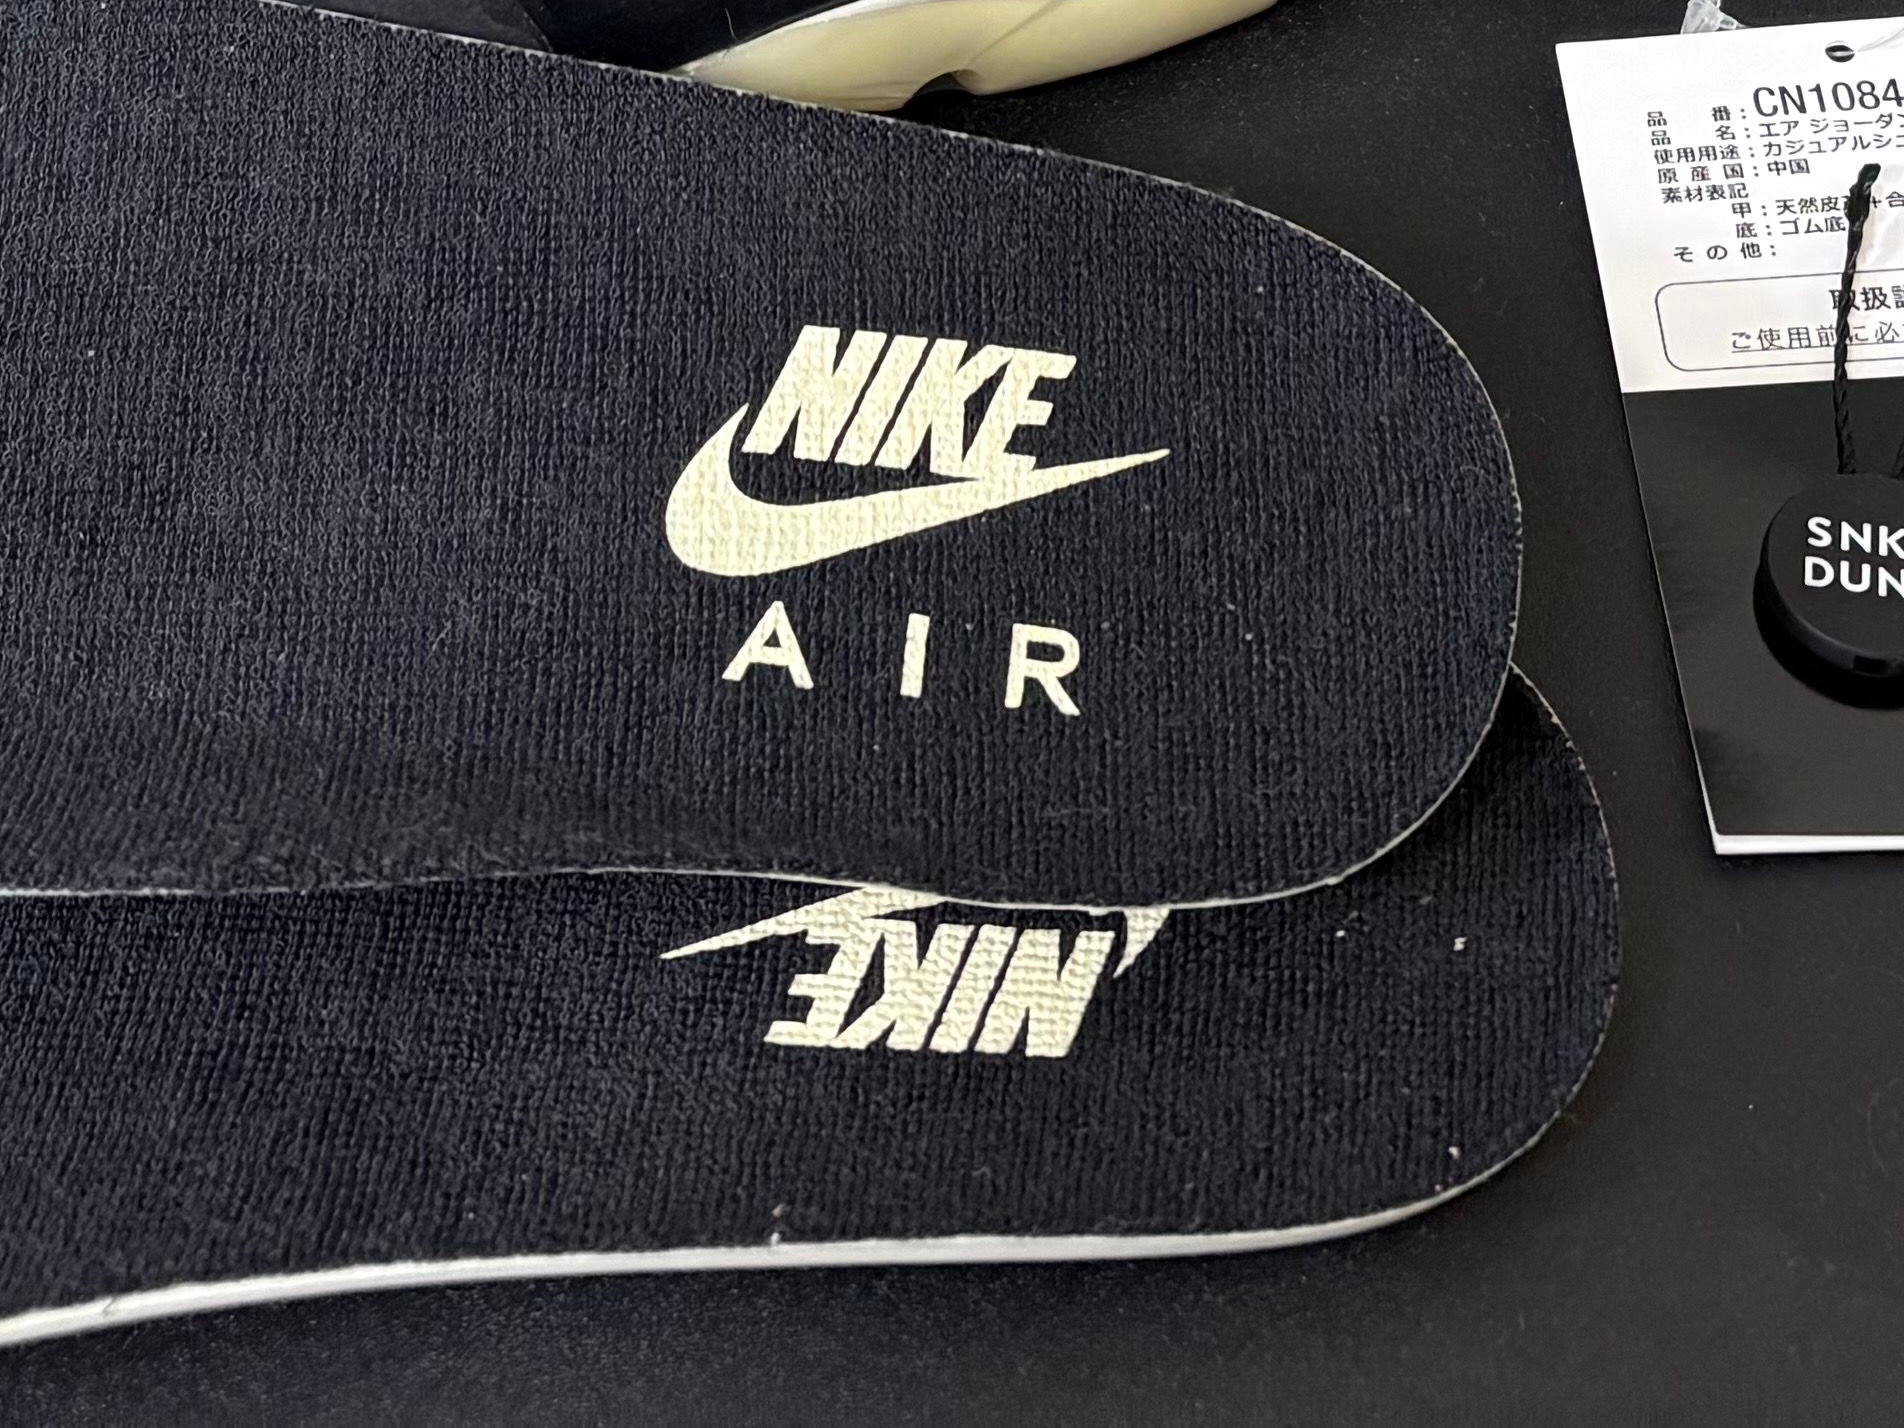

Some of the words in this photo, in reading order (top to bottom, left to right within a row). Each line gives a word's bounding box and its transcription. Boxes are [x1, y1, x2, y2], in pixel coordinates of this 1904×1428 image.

[1752, 77, 1904, 118] CN1084
[741, 324, 1078, 481] NIKE
[722, 600, 1083, 716] AIR
[764, 917, 1116, 1058] NIKE
